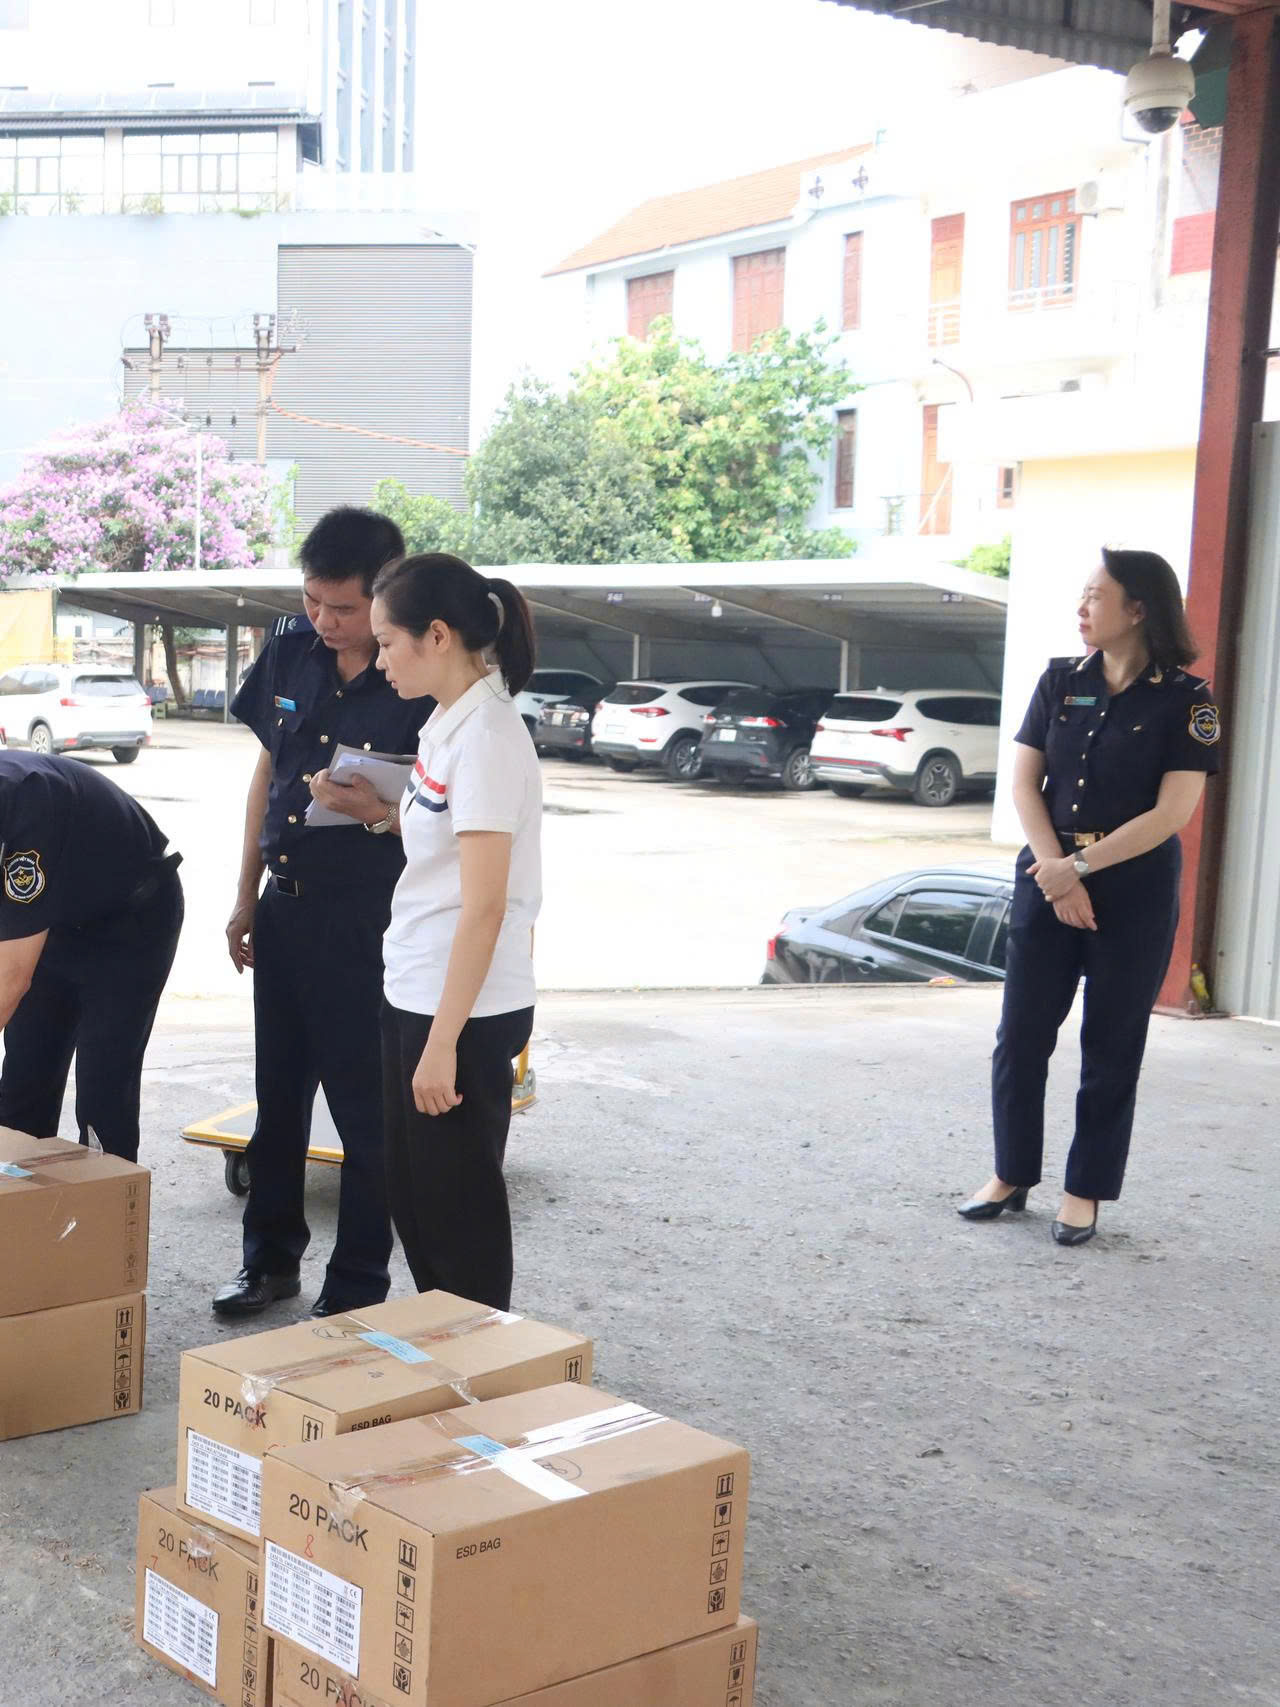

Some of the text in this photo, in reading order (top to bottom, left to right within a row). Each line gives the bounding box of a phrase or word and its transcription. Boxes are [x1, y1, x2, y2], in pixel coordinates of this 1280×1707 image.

[204, 1388, 267, 1429] 20 PACK
[351, 1414, 392, 1432] ESD BAG
[289, 1493, 311, 1520] 20
[315, 1505, 369, 1551] PACK
[158, 1527, 175, 1552] 20
[304, 1534, 314, 1558] 8
[455, 1537, 502, 1559] ESD BAG
[299, 1661, 320, 1690] 20
